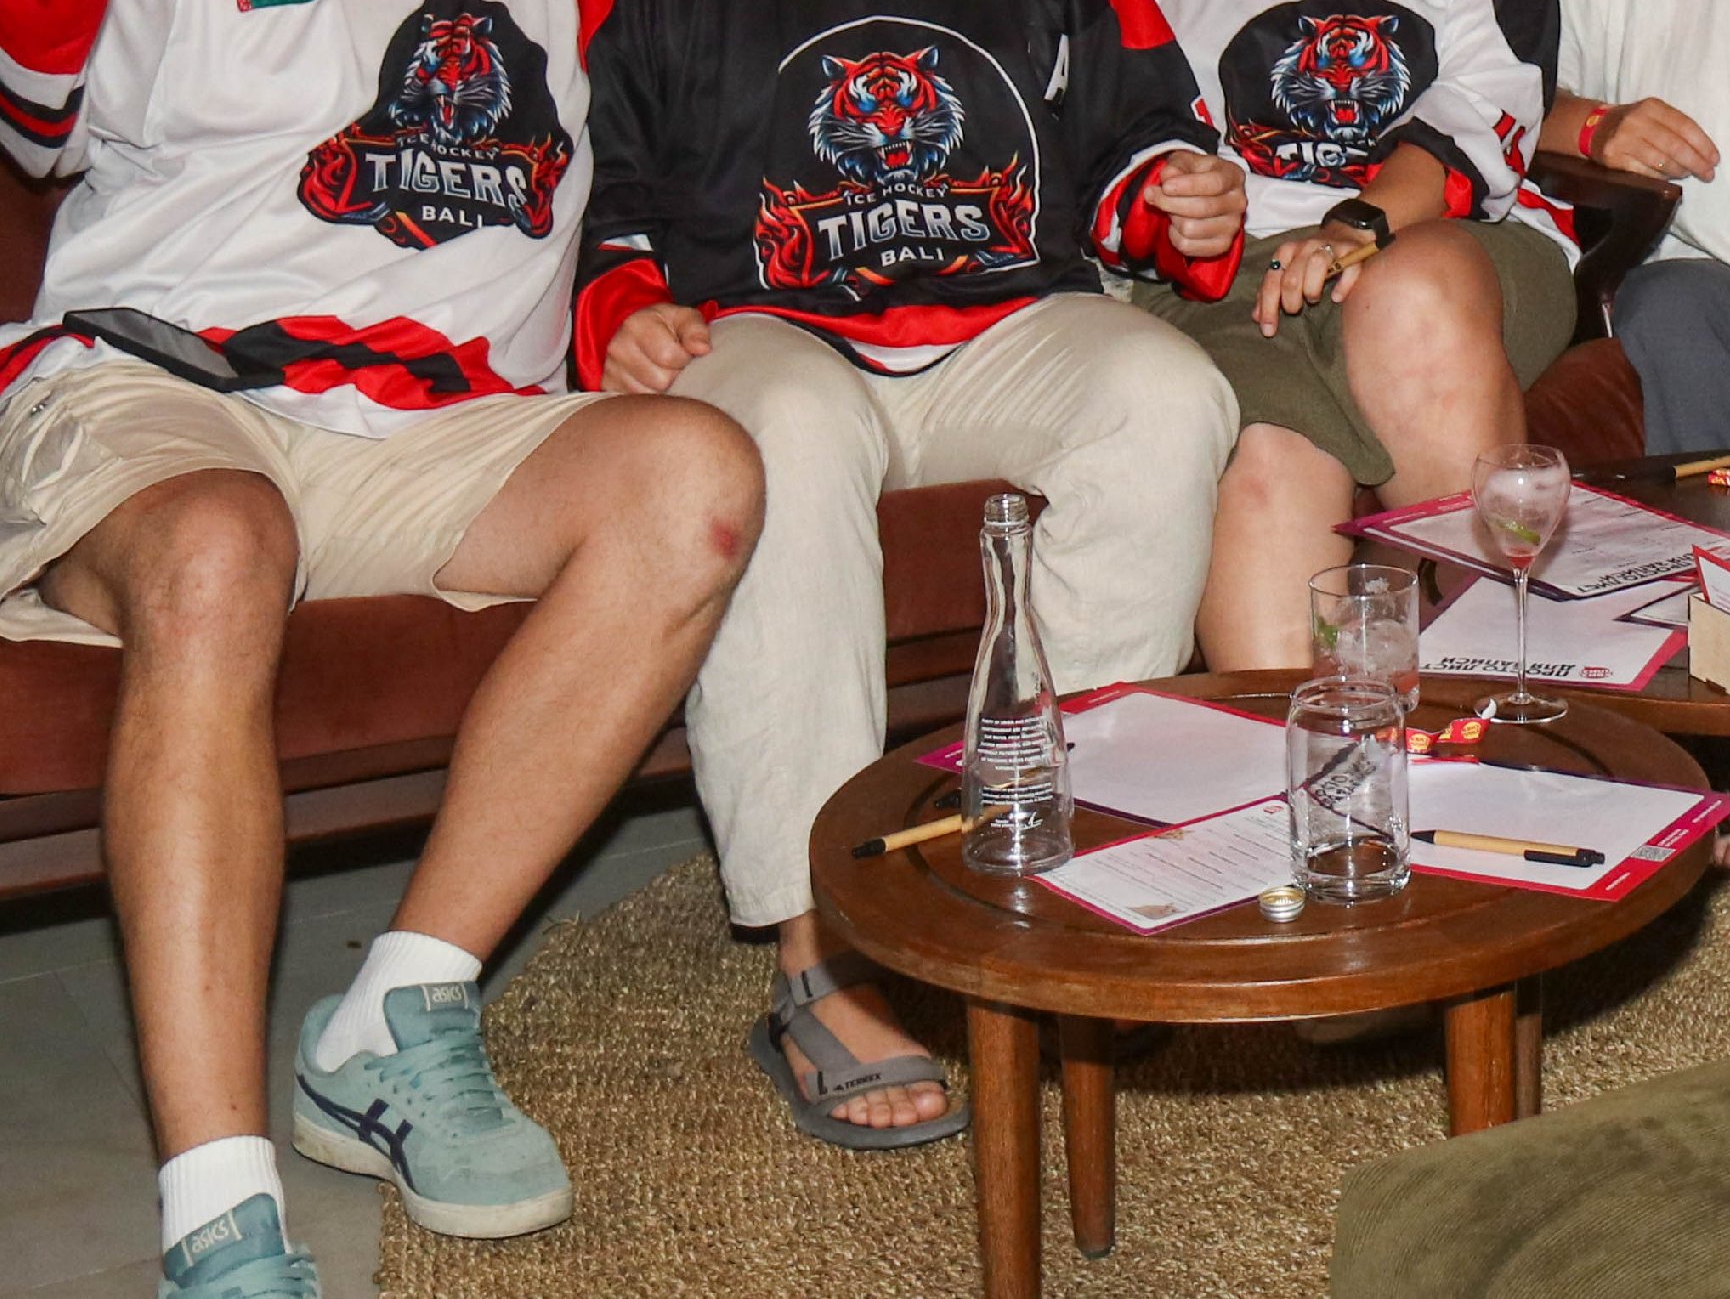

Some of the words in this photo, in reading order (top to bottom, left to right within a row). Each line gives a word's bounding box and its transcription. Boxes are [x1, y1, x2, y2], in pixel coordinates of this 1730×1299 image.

[365, 147, 527, 212] TIGERS
[882, 182, 947, 198] HOCKEY
[421, 204, 483, 229] BALI
[817, 199, 991, 261] TIGERS
[880, 245, 944, 267] BALI
